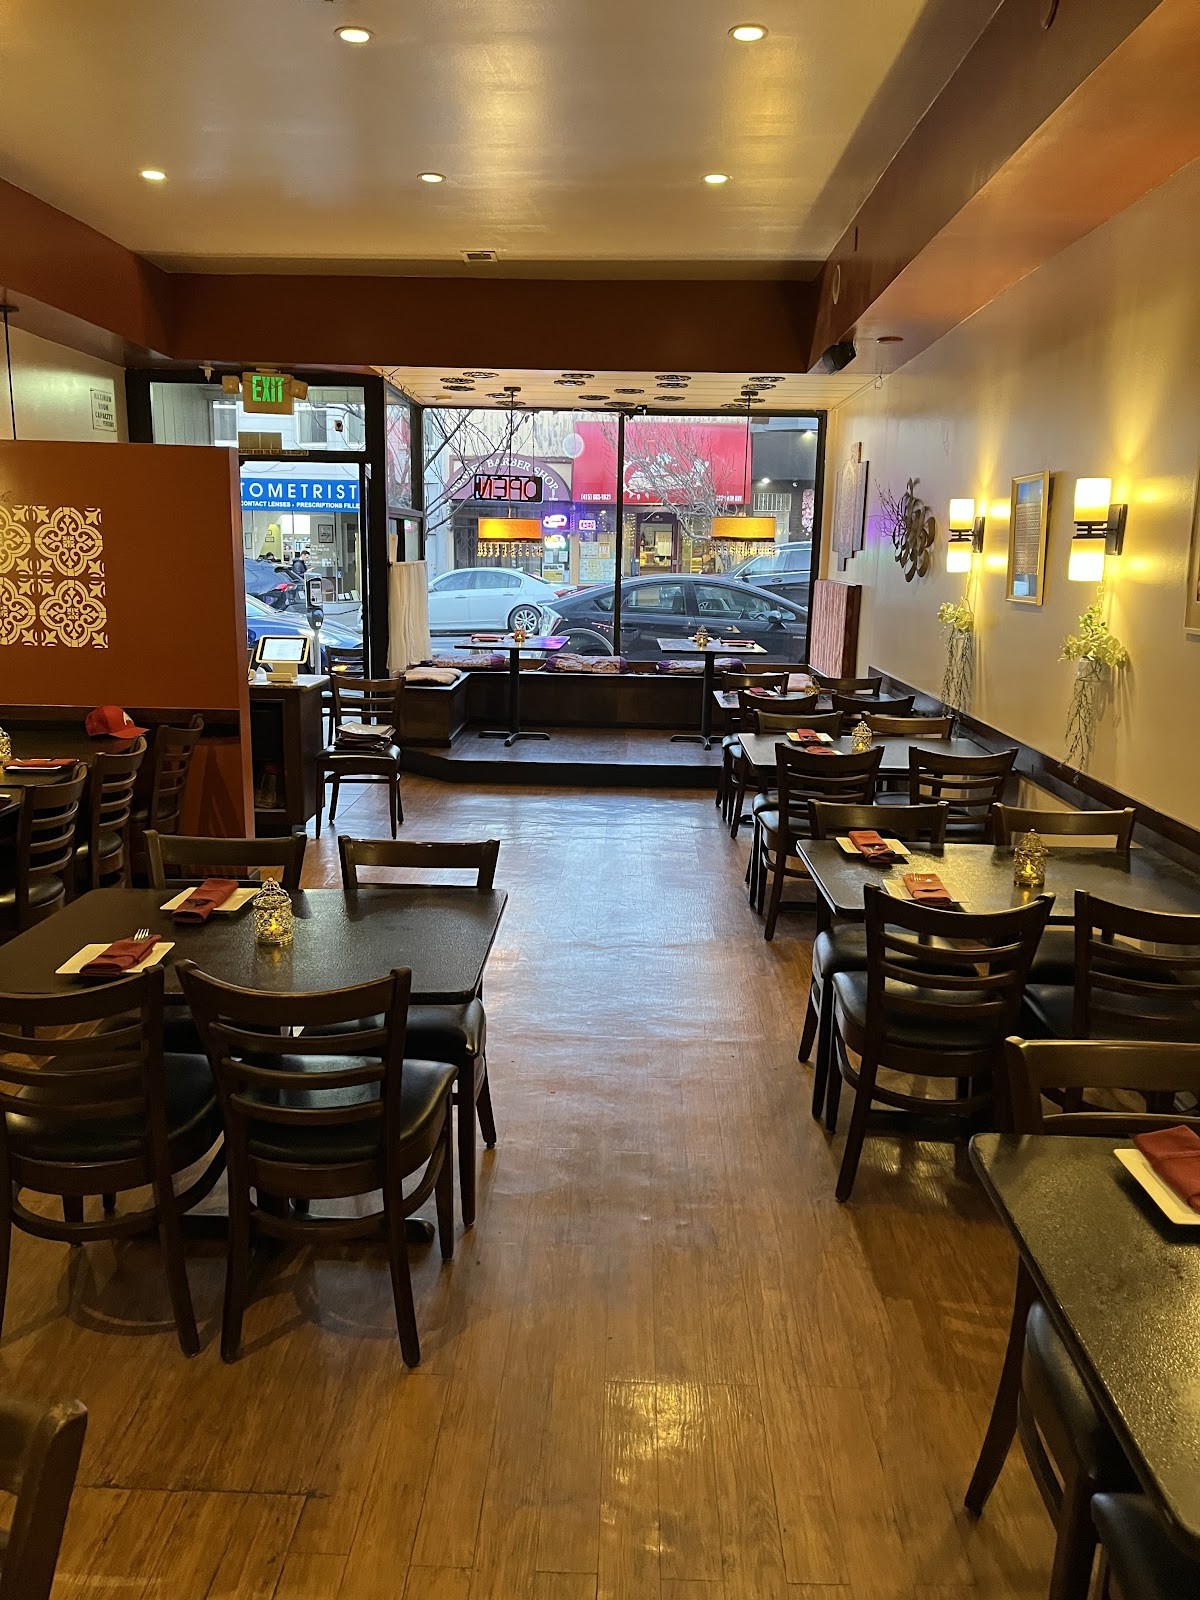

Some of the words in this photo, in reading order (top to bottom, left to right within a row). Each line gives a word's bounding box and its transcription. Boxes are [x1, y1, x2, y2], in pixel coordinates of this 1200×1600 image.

[252, 375, 285, 403] EXIT
[486, 457, 531, 472] BARBER
[533, 466, 559, 490] SHOP
[296, 501, 343, 509] PRESCRIPTIONS
